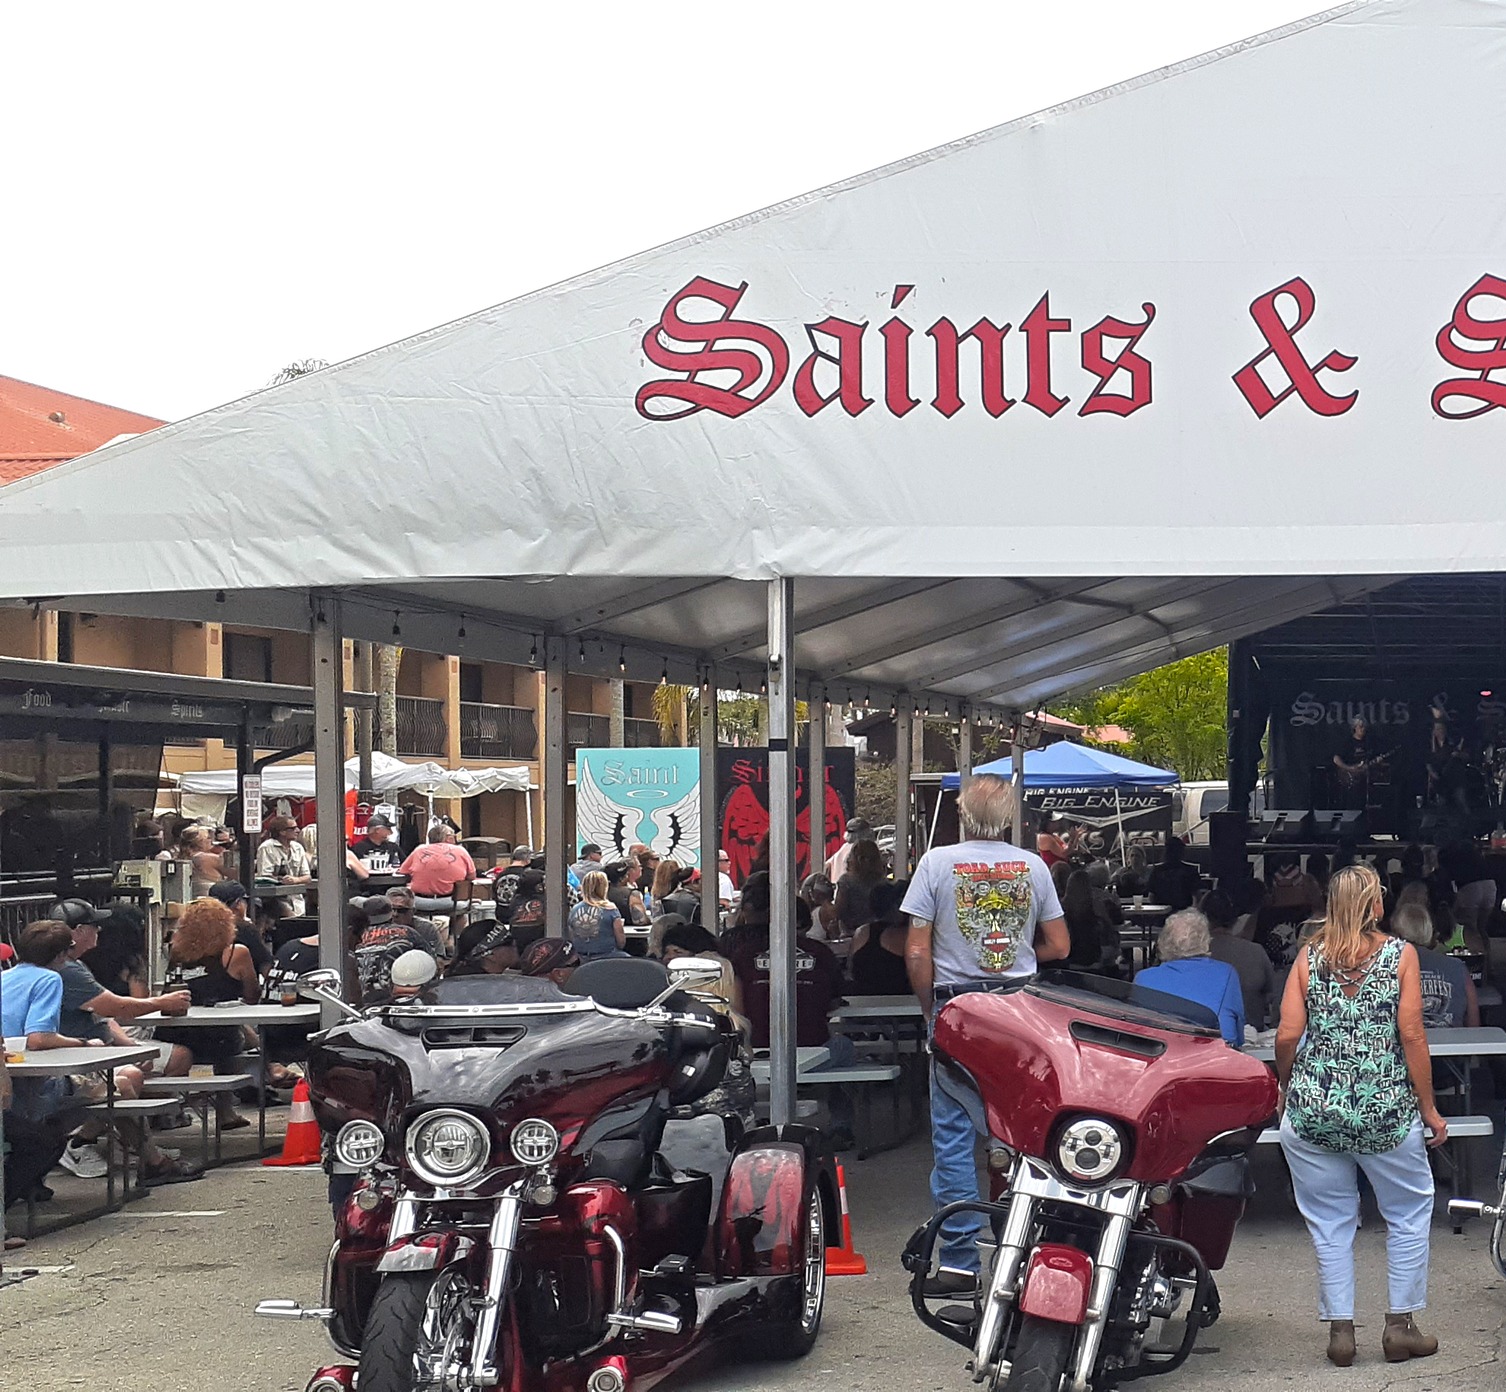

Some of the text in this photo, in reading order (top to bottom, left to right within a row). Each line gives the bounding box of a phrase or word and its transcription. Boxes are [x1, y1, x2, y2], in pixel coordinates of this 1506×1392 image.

[635, 275, 1154, 421] Saints
[1230, 276, 1360, 420] &
[22, 688, 52, 709] Food
[1290, 690, 1412, 727] Saints
[601, 759, 680, 786] Saint
[730, 759, 835, 783] Sinr
[1040, 795, 1161, 810] BIG ENGINE
[953, 861, 1027, 874] TOAD SUCK
